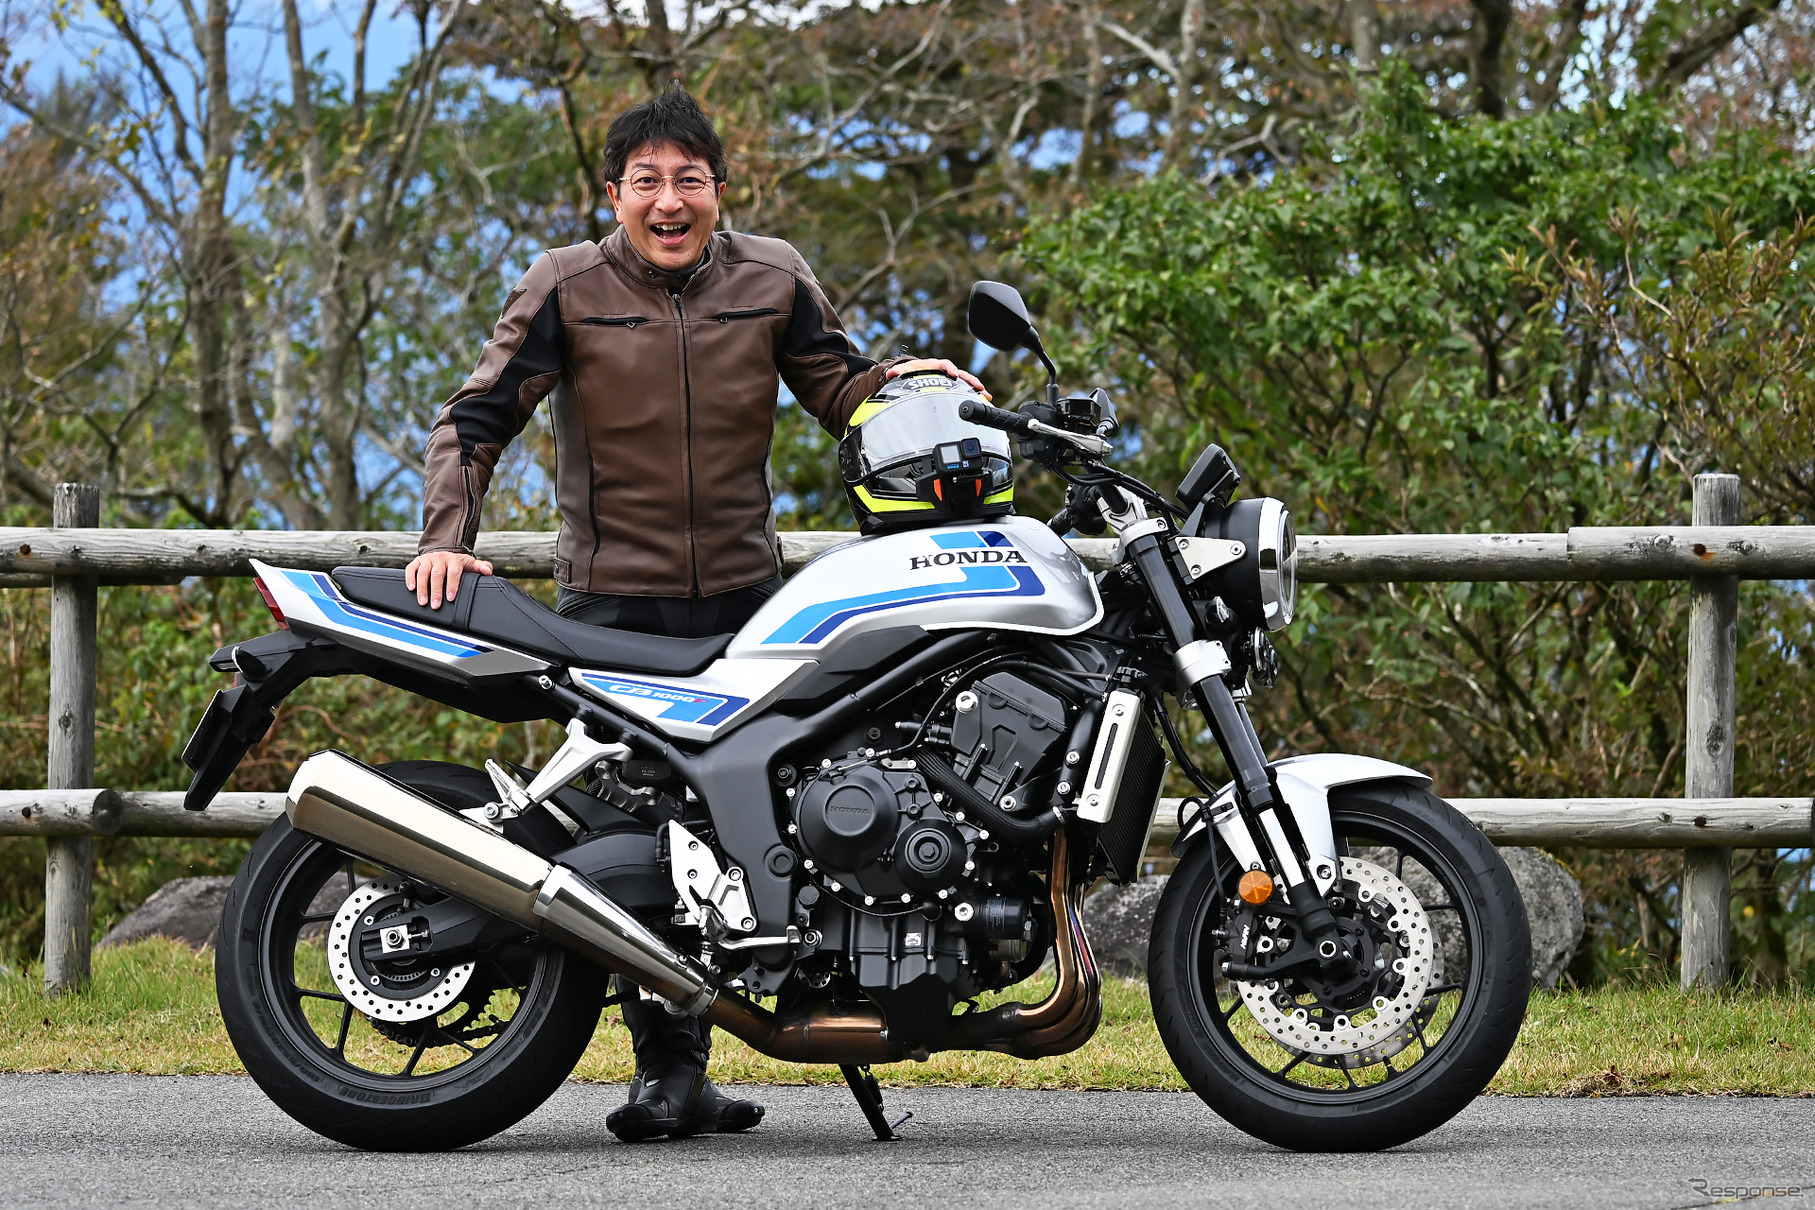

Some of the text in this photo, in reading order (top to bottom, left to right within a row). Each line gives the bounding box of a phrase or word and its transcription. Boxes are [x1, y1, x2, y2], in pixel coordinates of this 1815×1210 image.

[908, 378, 952, 389] SHOEI
[909, 550, 1028, 570] HONDA
[829, 806, 871, 815] HONDA
[338, 1088, 432, 1106] BRIDGESTONE
